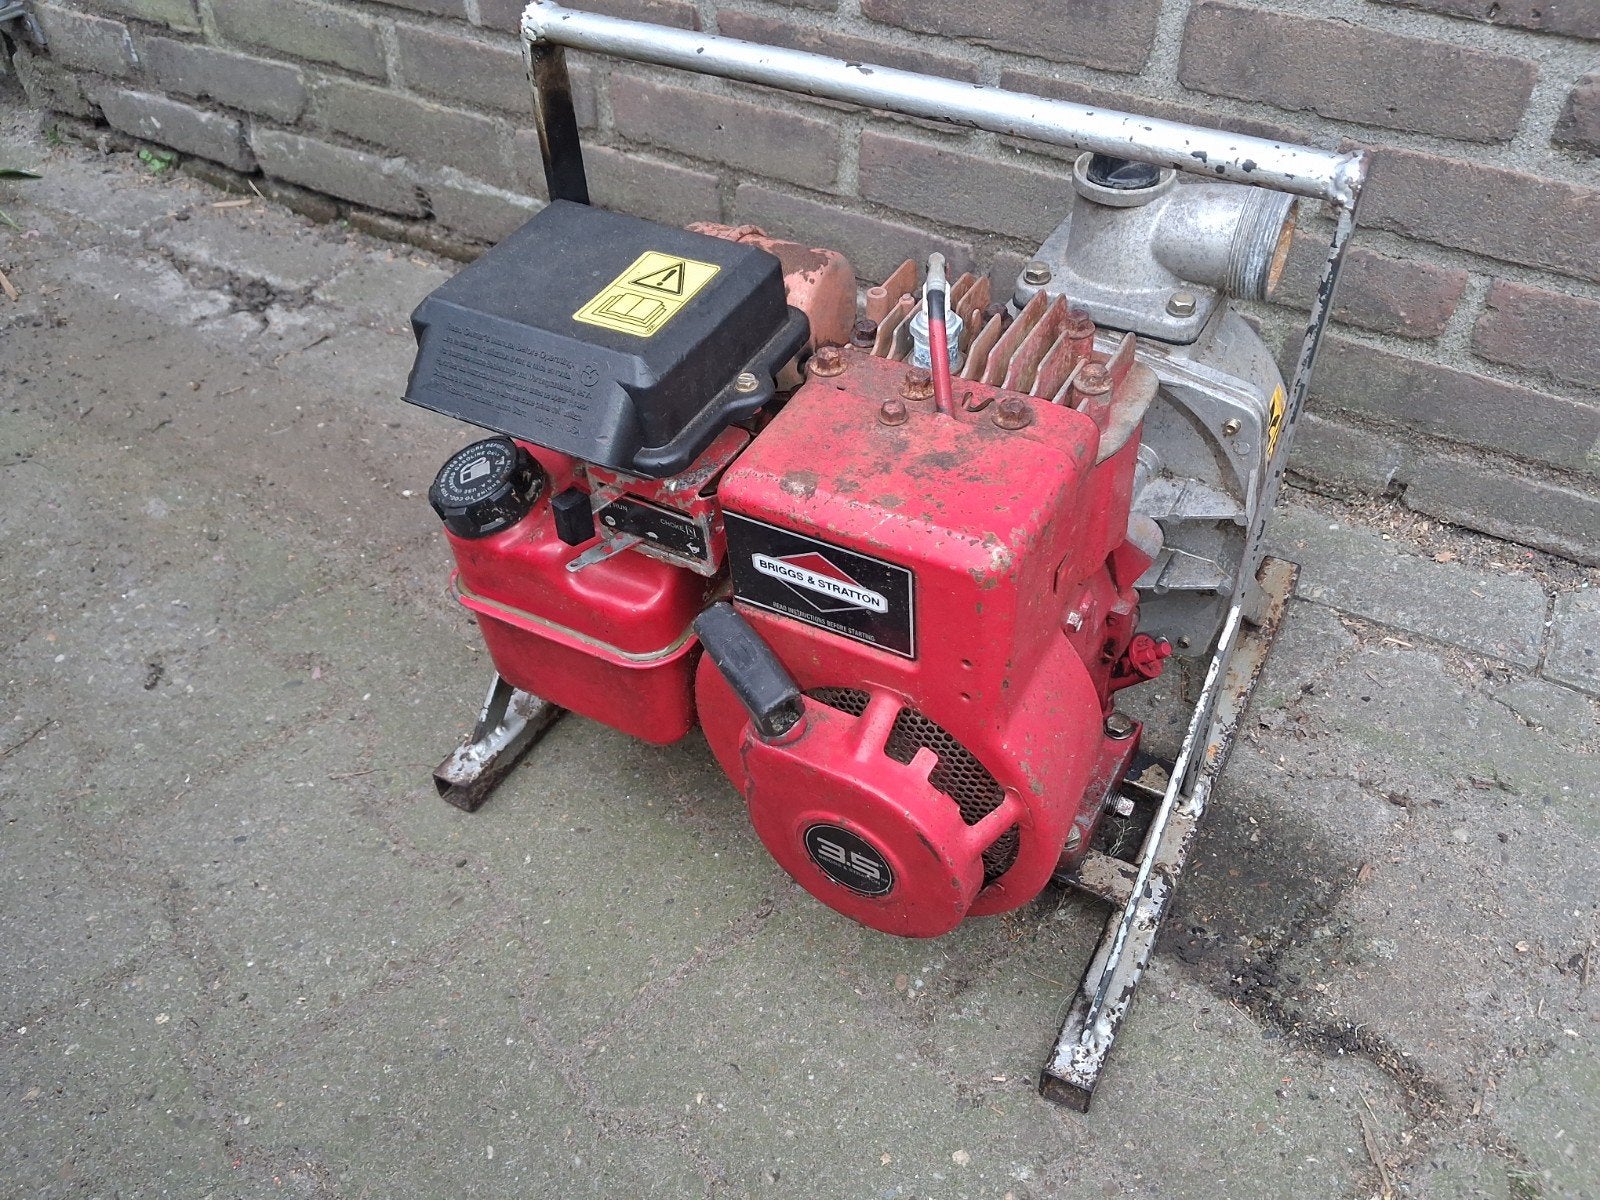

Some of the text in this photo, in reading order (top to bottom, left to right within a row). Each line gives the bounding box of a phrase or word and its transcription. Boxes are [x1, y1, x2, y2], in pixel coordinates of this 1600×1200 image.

[458, 445, 483, 459] BEFORE
[759, 558, 880, 606] BRIGGS & STRATTON
[772, 601, 788, 612] READ
[787, 606, 826, 625] INSTRUCTIONS
[826, 617, 847, 633] BEFORE
[817, 837, 880, 879] 3.5
